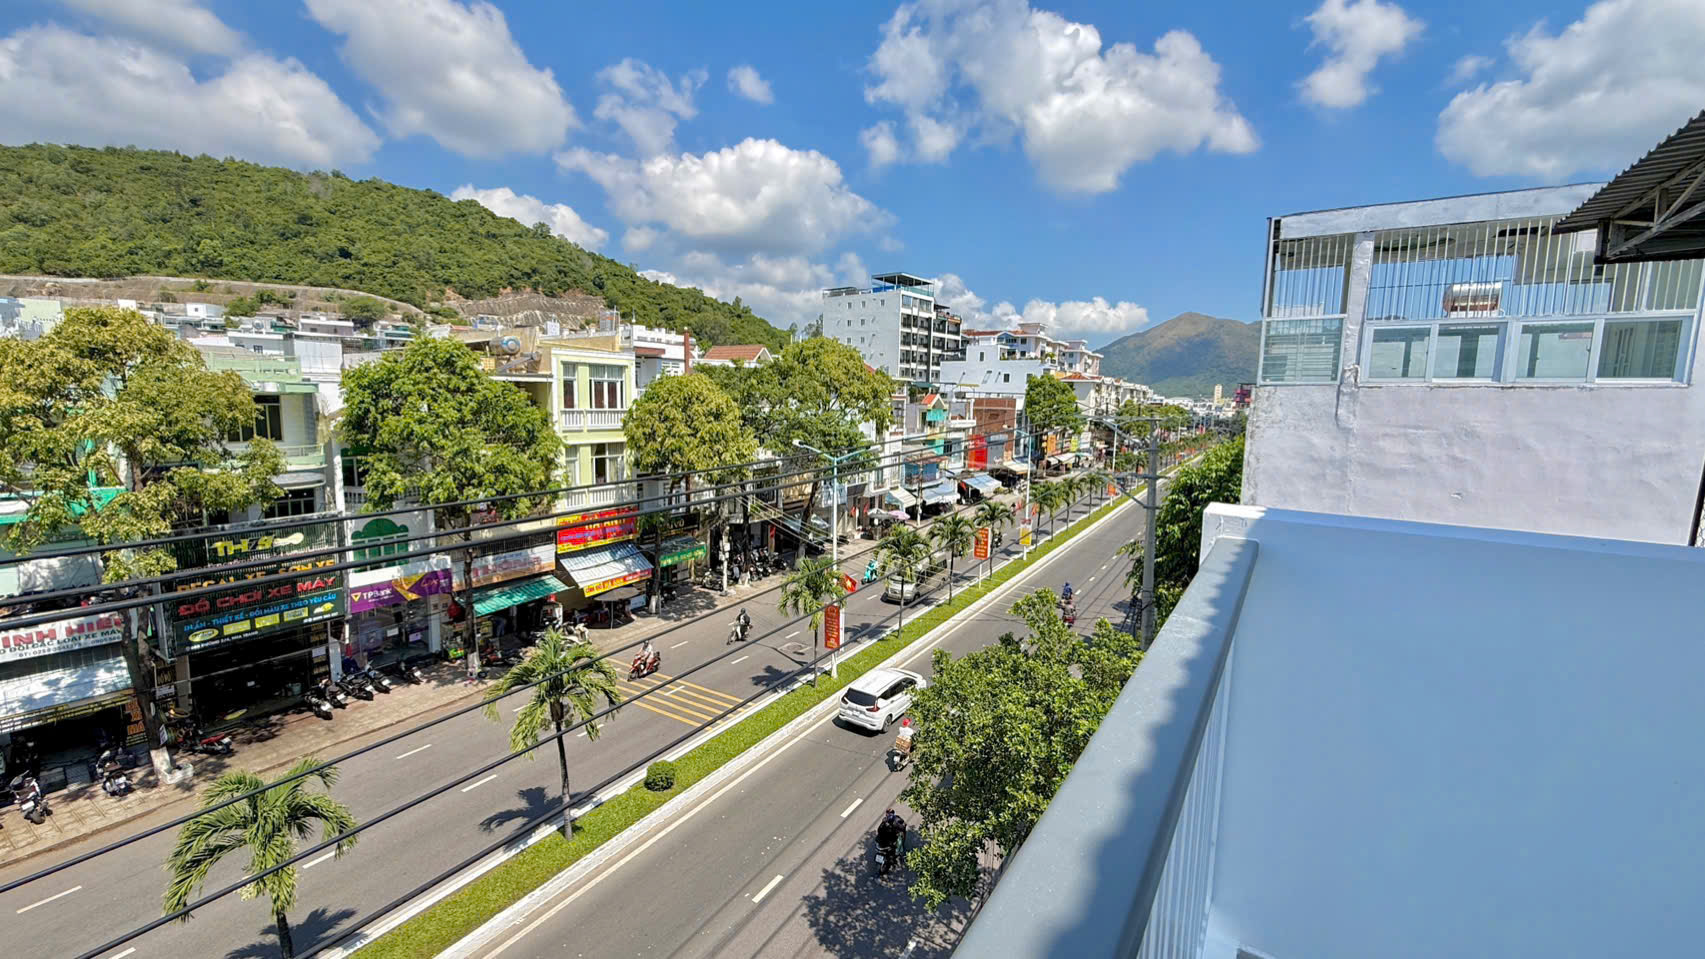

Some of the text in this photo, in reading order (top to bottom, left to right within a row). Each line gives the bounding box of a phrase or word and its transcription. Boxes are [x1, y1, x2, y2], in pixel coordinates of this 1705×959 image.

[267, 585, 292, 598] XE
[296, 576, 337, 592] MÁY
[362, 587, 392, 599] TPBank
[84, 632, 97, 640] XE
